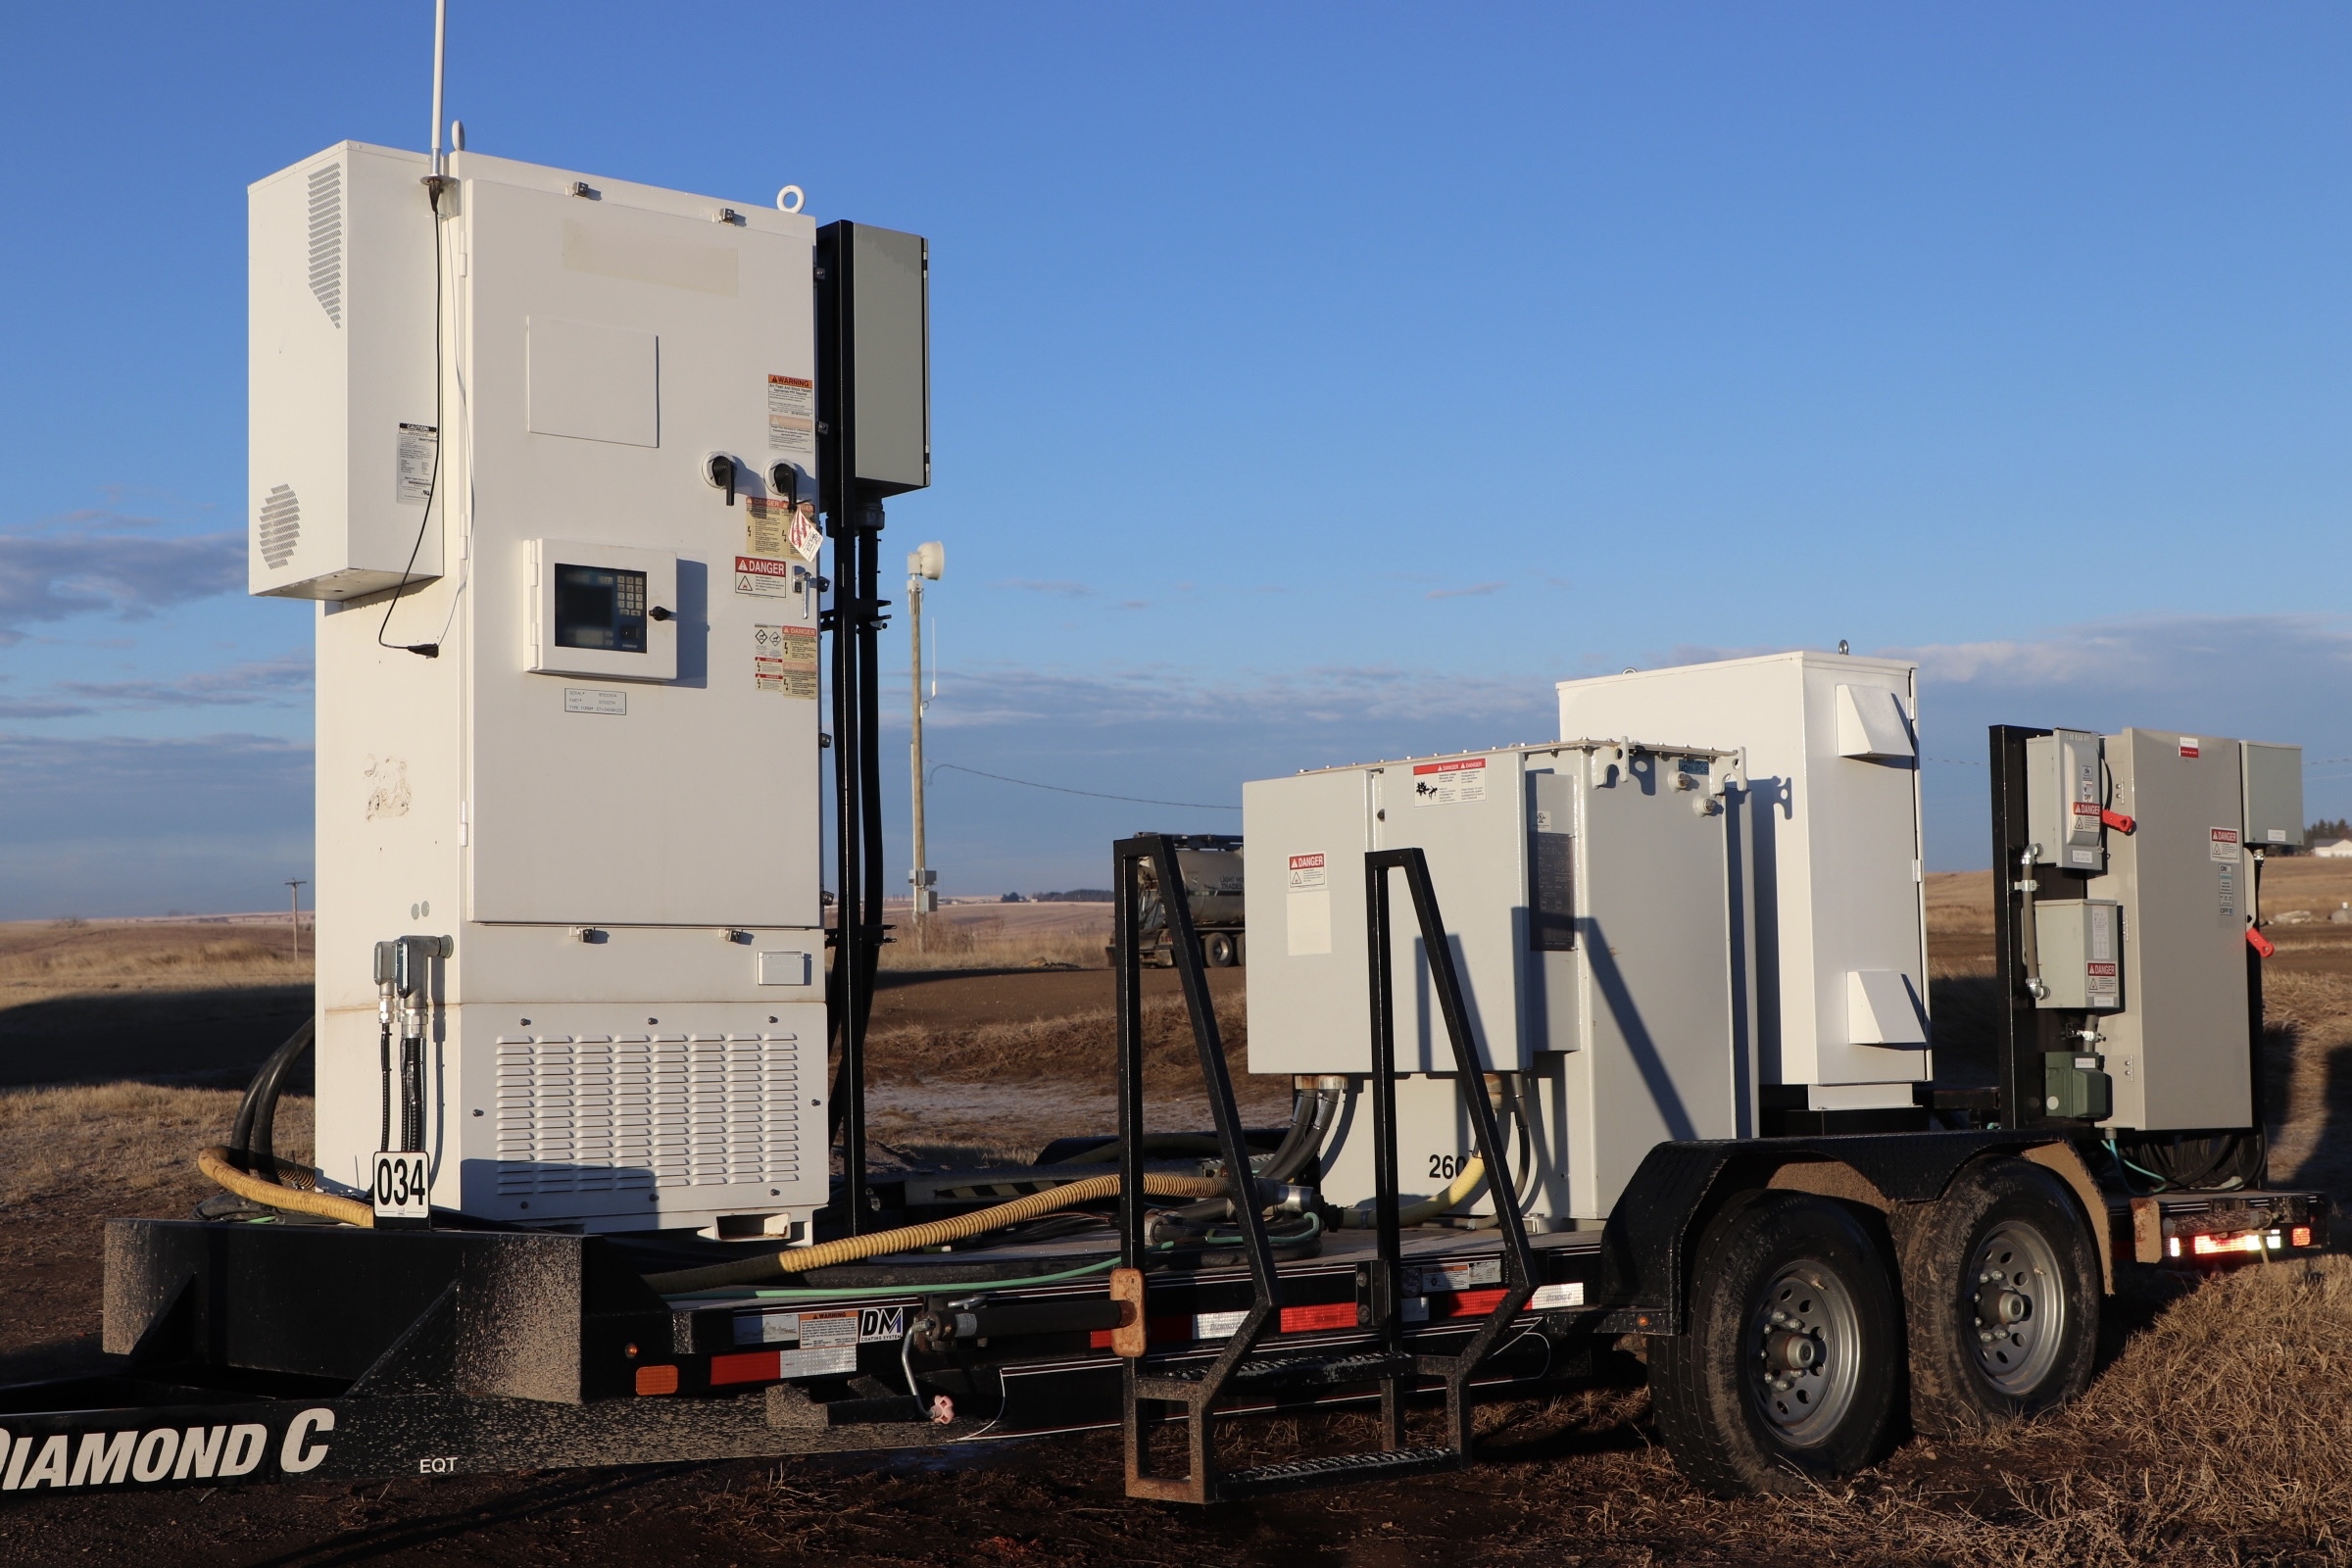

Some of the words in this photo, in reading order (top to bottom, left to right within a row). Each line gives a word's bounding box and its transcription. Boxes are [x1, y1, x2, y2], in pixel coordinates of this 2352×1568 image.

[777, 376, 809, 387] WARNING
[749, 560, 785, 575] DANGER
[2218, 831, 2237, 842] DANGER
[1298, 855, 1324, 868] DANGER
[2094, 964, 2115, 976] DANGER
[377, 1158, 425, 1206] 034
[861, 1308, 903, 1337] DM
[0, 1423, 268, 1491] IAMOND
[280, 1407, 335, 1473] C
[419, 1456, 459, 1474] EQT
